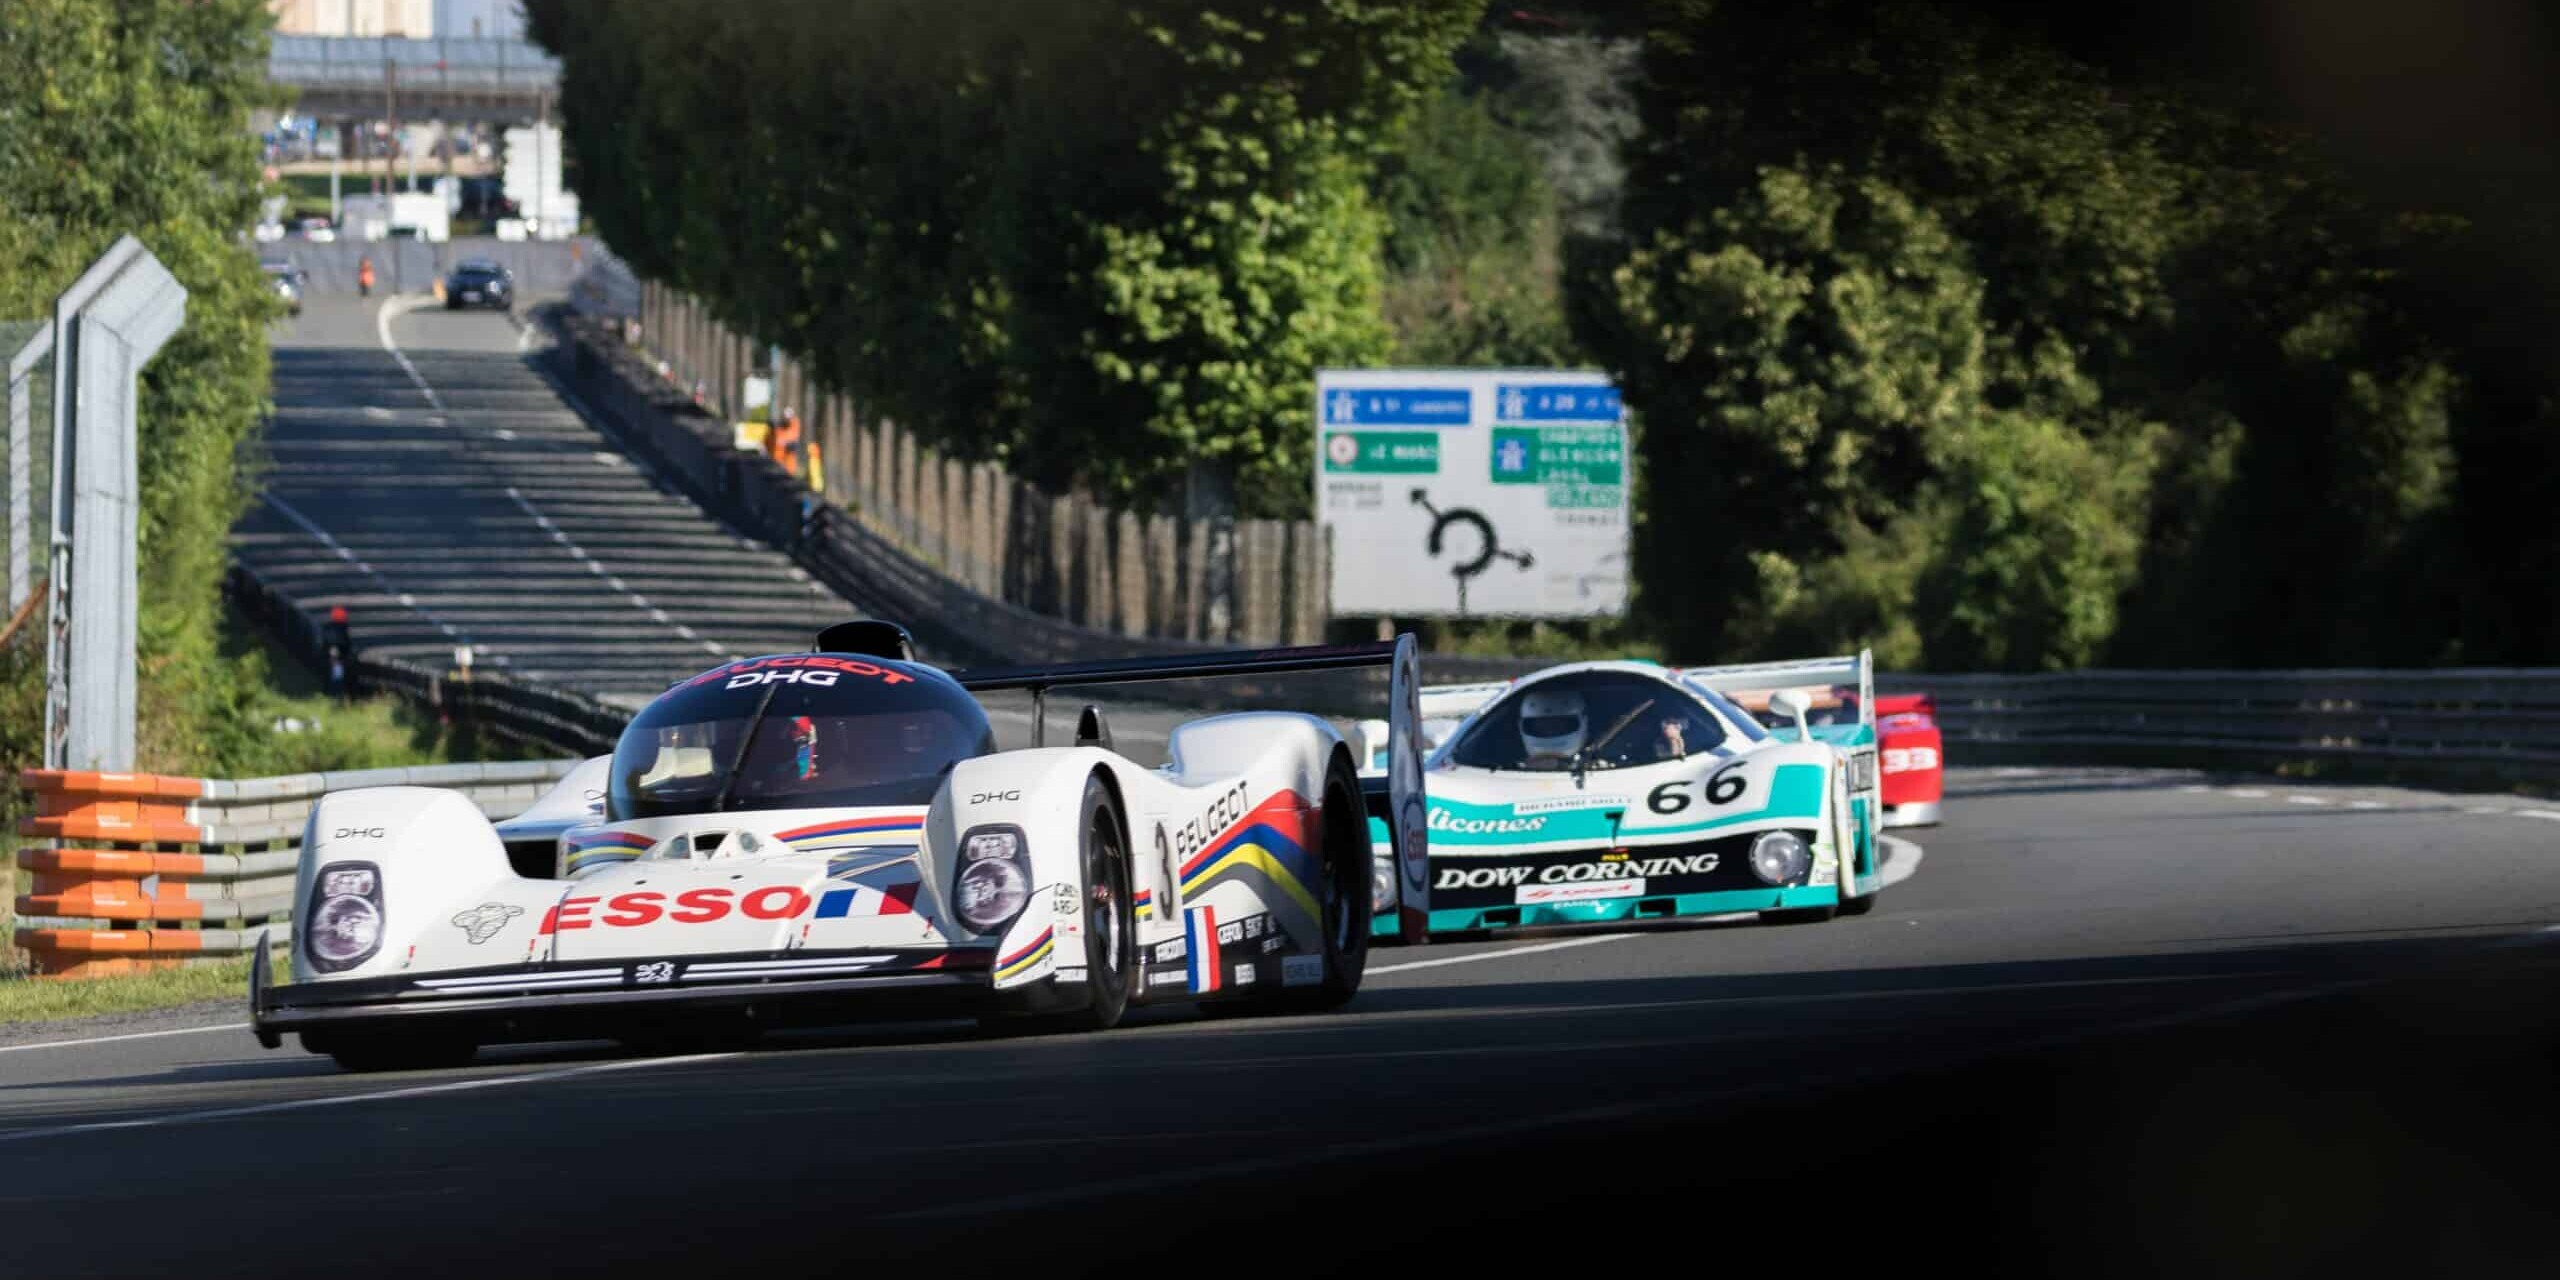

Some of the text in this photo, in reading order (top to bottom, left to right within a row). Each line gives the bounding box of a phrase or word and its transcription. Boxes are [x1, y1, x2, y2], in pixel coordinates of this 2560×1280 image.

[664, 657, 915, 700] EUGEOT
[726, 669, 841, 690] DHG
[1881, 747, 1938, 774] 33
[969, 790, 1021, 805] DHG
[1647, 761, 1748, 815] 66
[334, 827, 385, 839] DHG
[1176, 780, 1248, 863] PEUGEOT
[1427, 806, 1547, 833] licones
[1154, 820, 1174, 922] 3
[1433, 866, 1534, 890] DOW
[1539, 853, 1720, 885] CORNING
[538, 885, 812, 936] ESSO
